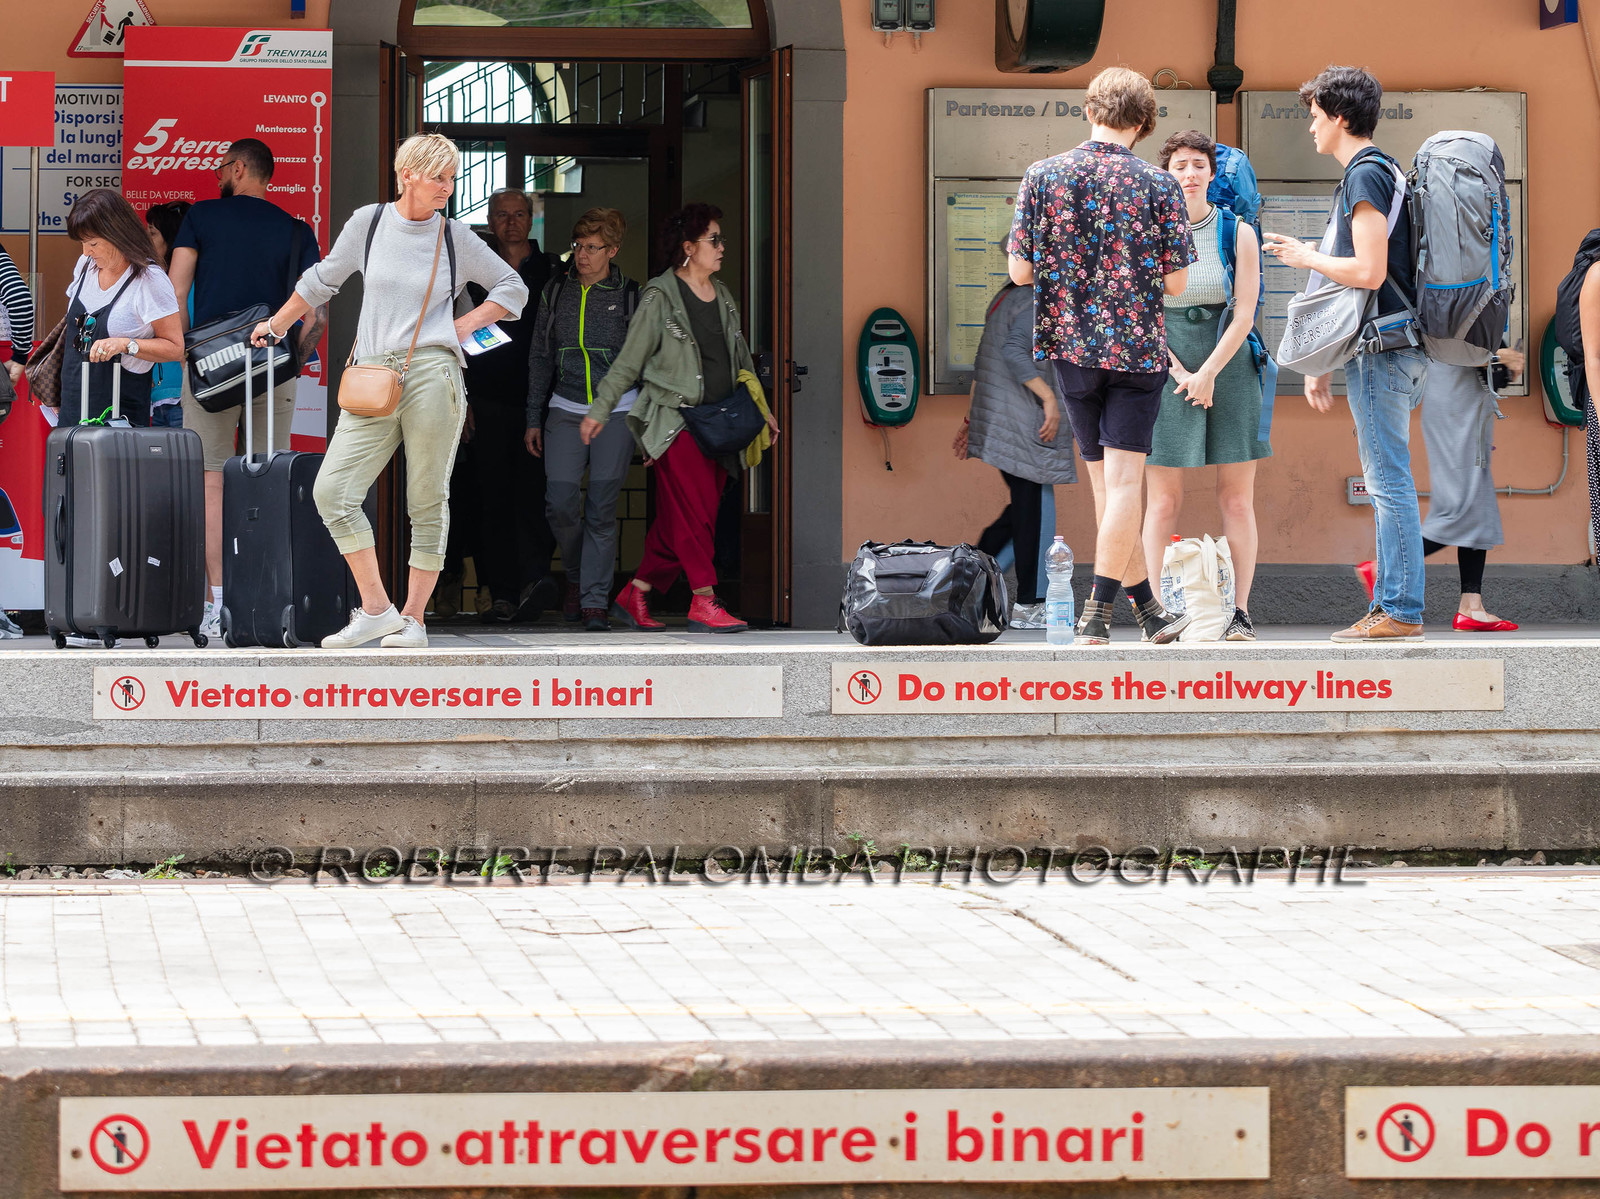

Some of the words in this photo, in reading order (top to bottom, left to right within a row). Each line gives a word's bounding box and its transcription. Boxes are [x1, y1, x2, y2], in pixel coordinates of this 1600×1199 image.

[86, 0, 103, 24] SECURITY
[266, 49, 328, 58] TRENITALIA
[55, 93, 102, 105] MOTIVI
[106, 94, 119, 105] DI
[263, 94, 308, 104] LEVANTO
[946, 100, 1036, 118] Partenze
[61, 129, 76, 144] la
[133, 118, 179, 155] 5
[170, 137, 233, 154] terre
[255, 124, 308, 134] Monterosso
[46, 149, 72, 164] del
[126, 155, 224, 176] express
[66, 176, 93, 188] FOR
[265, 183, 306, 195] Corniglia
[126, 190, 148, 199] BELLE
[149, 190, 162, 199] DA
[163, 190, 196, 200] VEDERE,
[194, 341, 247, 378] PUMA
[165, 679, 292, 708] Vietato
[302, 681, 522, 708] attraversare
[532, 679, 541, 707] i
[551, 678, 653, 707] binari
[898, 673, 946, 702] Do
[955, 676, 1012, 702] not
[1019, 680, 1104, 701] cross
[1111, 671, 1167, 701] the
[1177, 670, 1308, 707] railway
[1316, 670, 1393, 700] lines
[182, 1117, 430, 1170] Vietato
[454, 1118, 878, 1167] attraversare
[903, 1110, 918, 1163] i
[946, 1109, 1145, 1163] binari
[1465, 1108, 1552, 1158] Do
